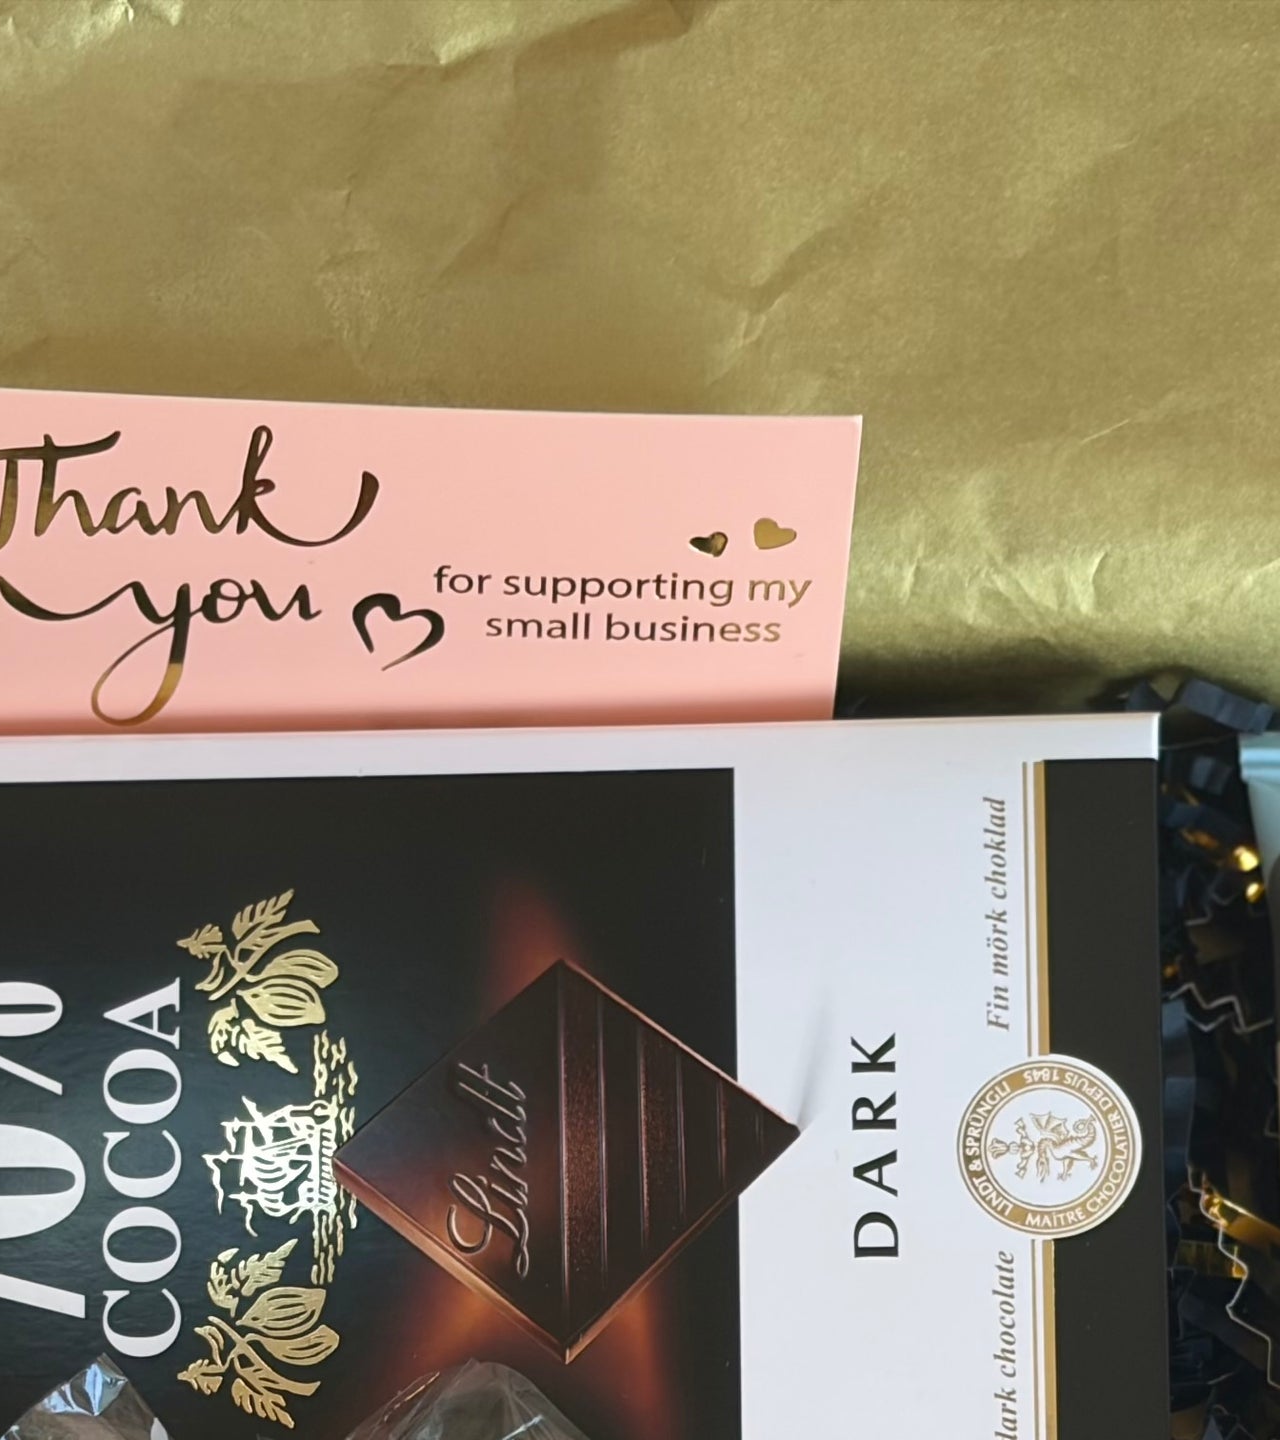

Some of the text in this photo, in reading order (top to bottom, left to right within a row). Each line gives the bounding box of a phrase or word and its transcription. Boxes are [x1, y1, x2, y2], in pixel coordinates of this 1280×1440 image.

[433, 564, 812, 607] for supporting my
[485, 610, 783, 645] small business
[983, 796, 1011, 1032] Fin mörk choklad
[102, 976, 182, 1358] COCOA
[446, 1062, 530, 1280] Lindt
[849, 1032, 900, 1260] DARK
[965, 1080, 1015, 1217] LINDT & SPRÜNGLI
[1022, 1067, 1129, 1229] MAÎTRE CHOCOLATIER DEPUIS 1845
[993, 1250, 1016, 1386] chocolate
